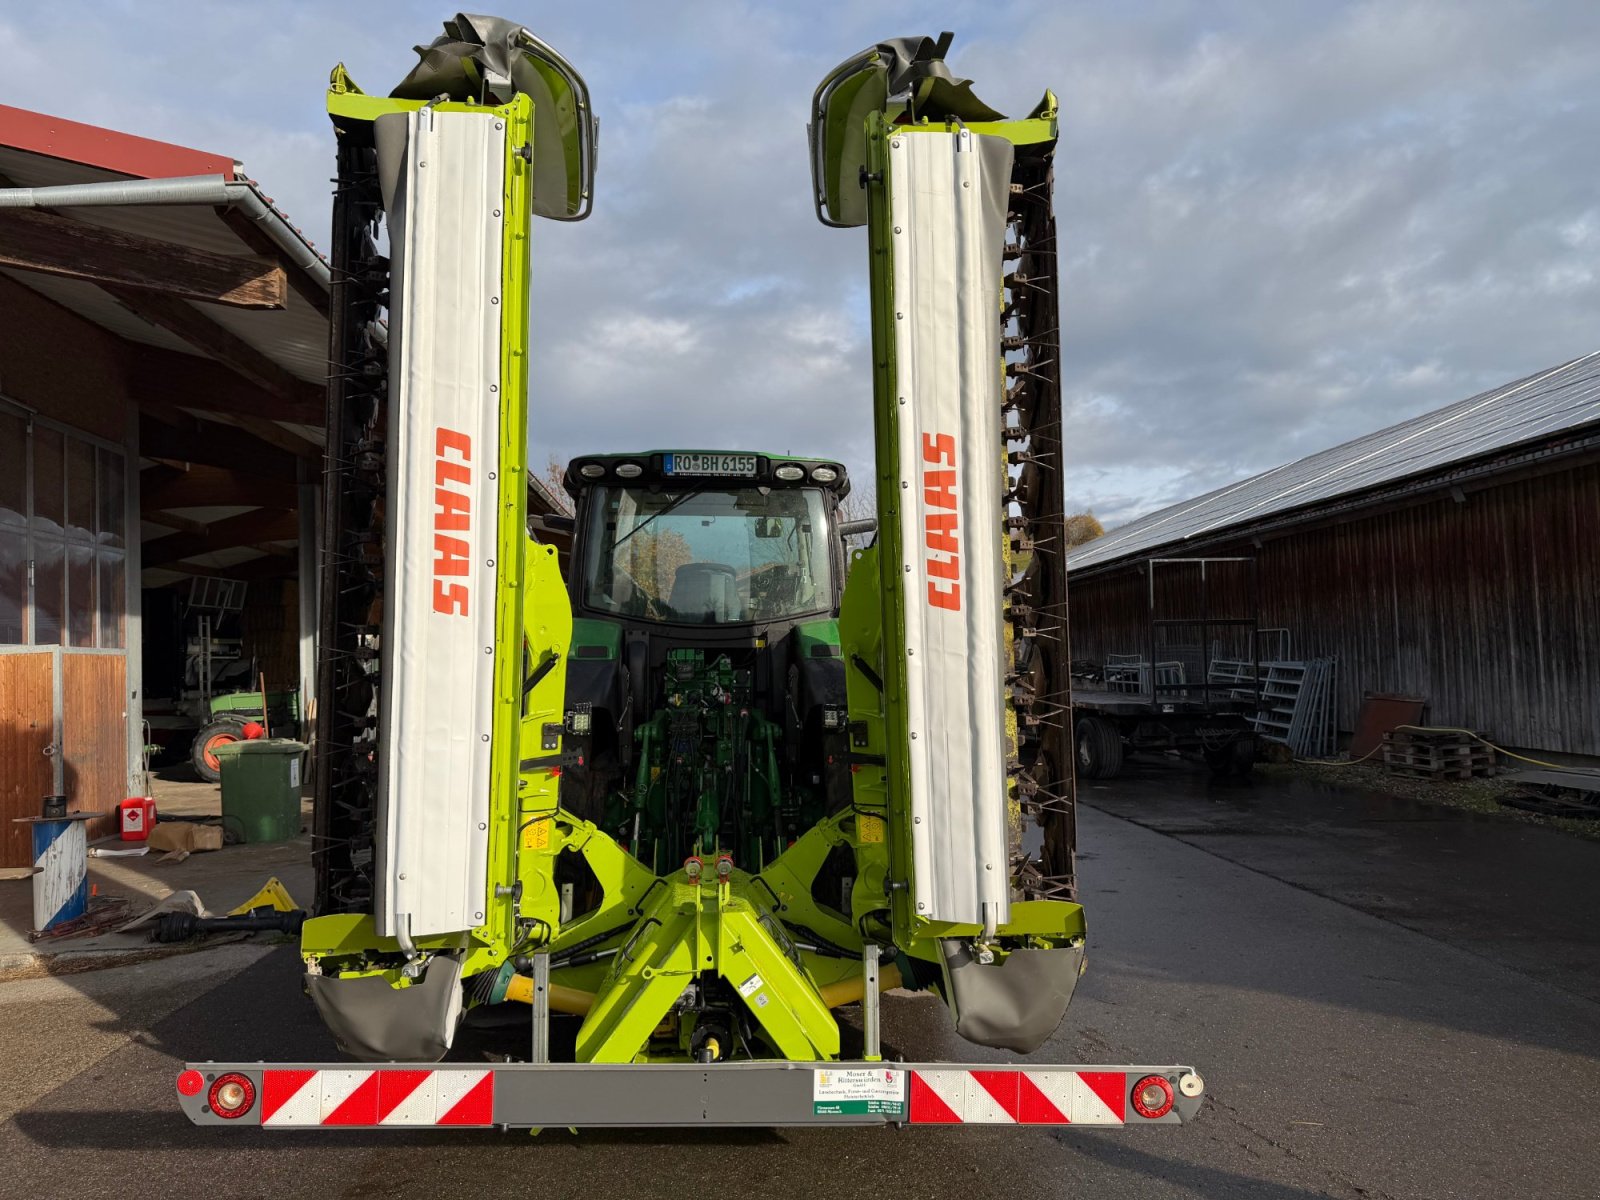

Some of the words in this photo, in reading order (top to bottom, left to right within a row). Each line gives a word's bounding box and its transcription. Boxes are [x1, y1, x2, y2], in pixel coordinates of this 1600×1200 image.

[433, 427, 471, 617] CLAAS
[674, 455, 691, 471] RO
[701, 456, 719, 471] BH
[721, 456, 755, 472] 6155
[922, 432, 960, 611] CLAAS
